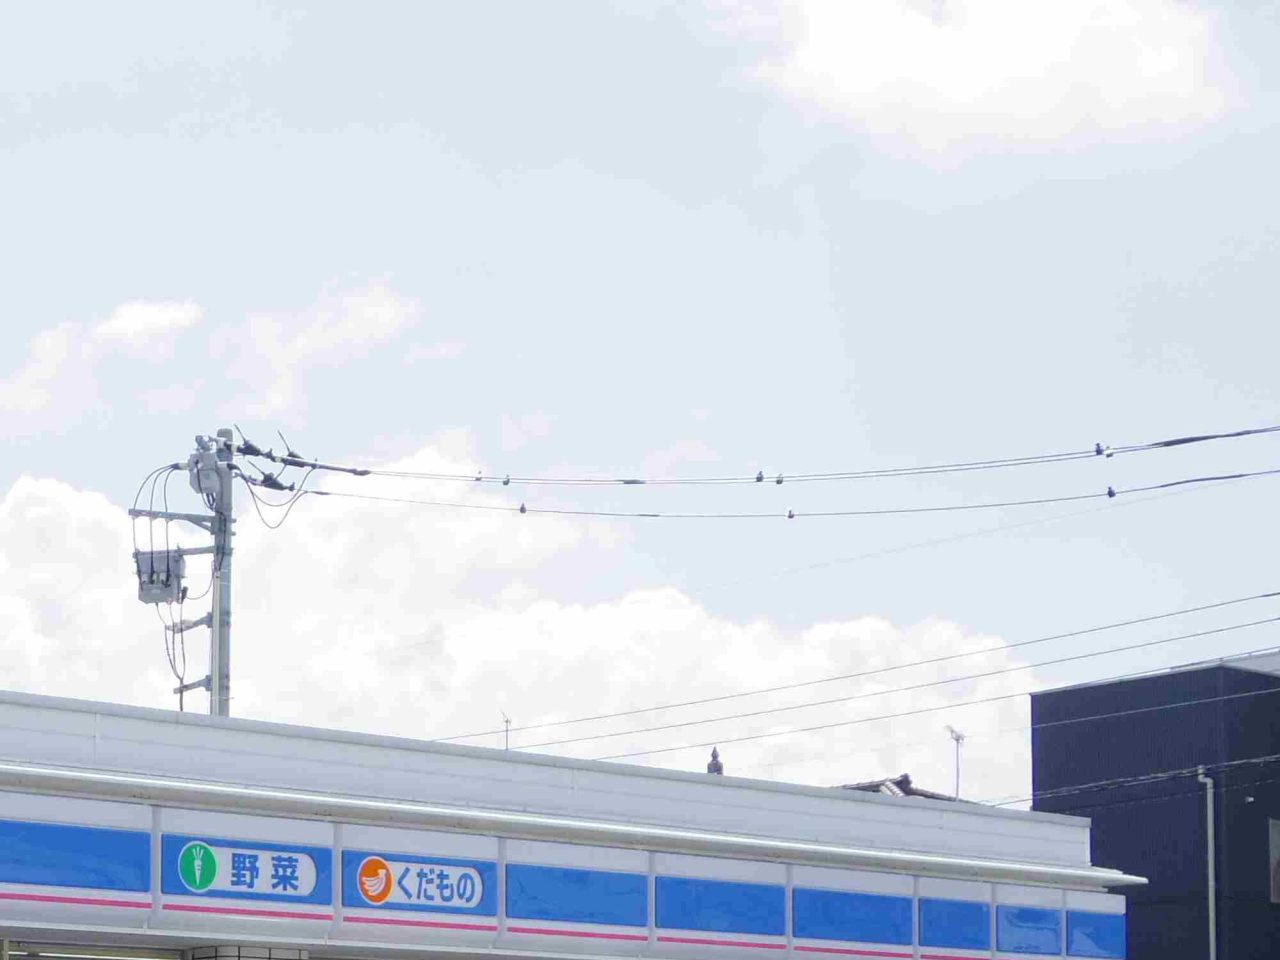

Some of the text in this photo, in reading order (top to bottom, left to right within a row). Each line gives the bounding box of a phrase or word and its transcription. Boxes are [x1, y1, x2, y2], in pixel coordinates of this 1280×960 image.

[230, 851, 300, 891] 野菜
[397, 866, 475, 903] くだもの
